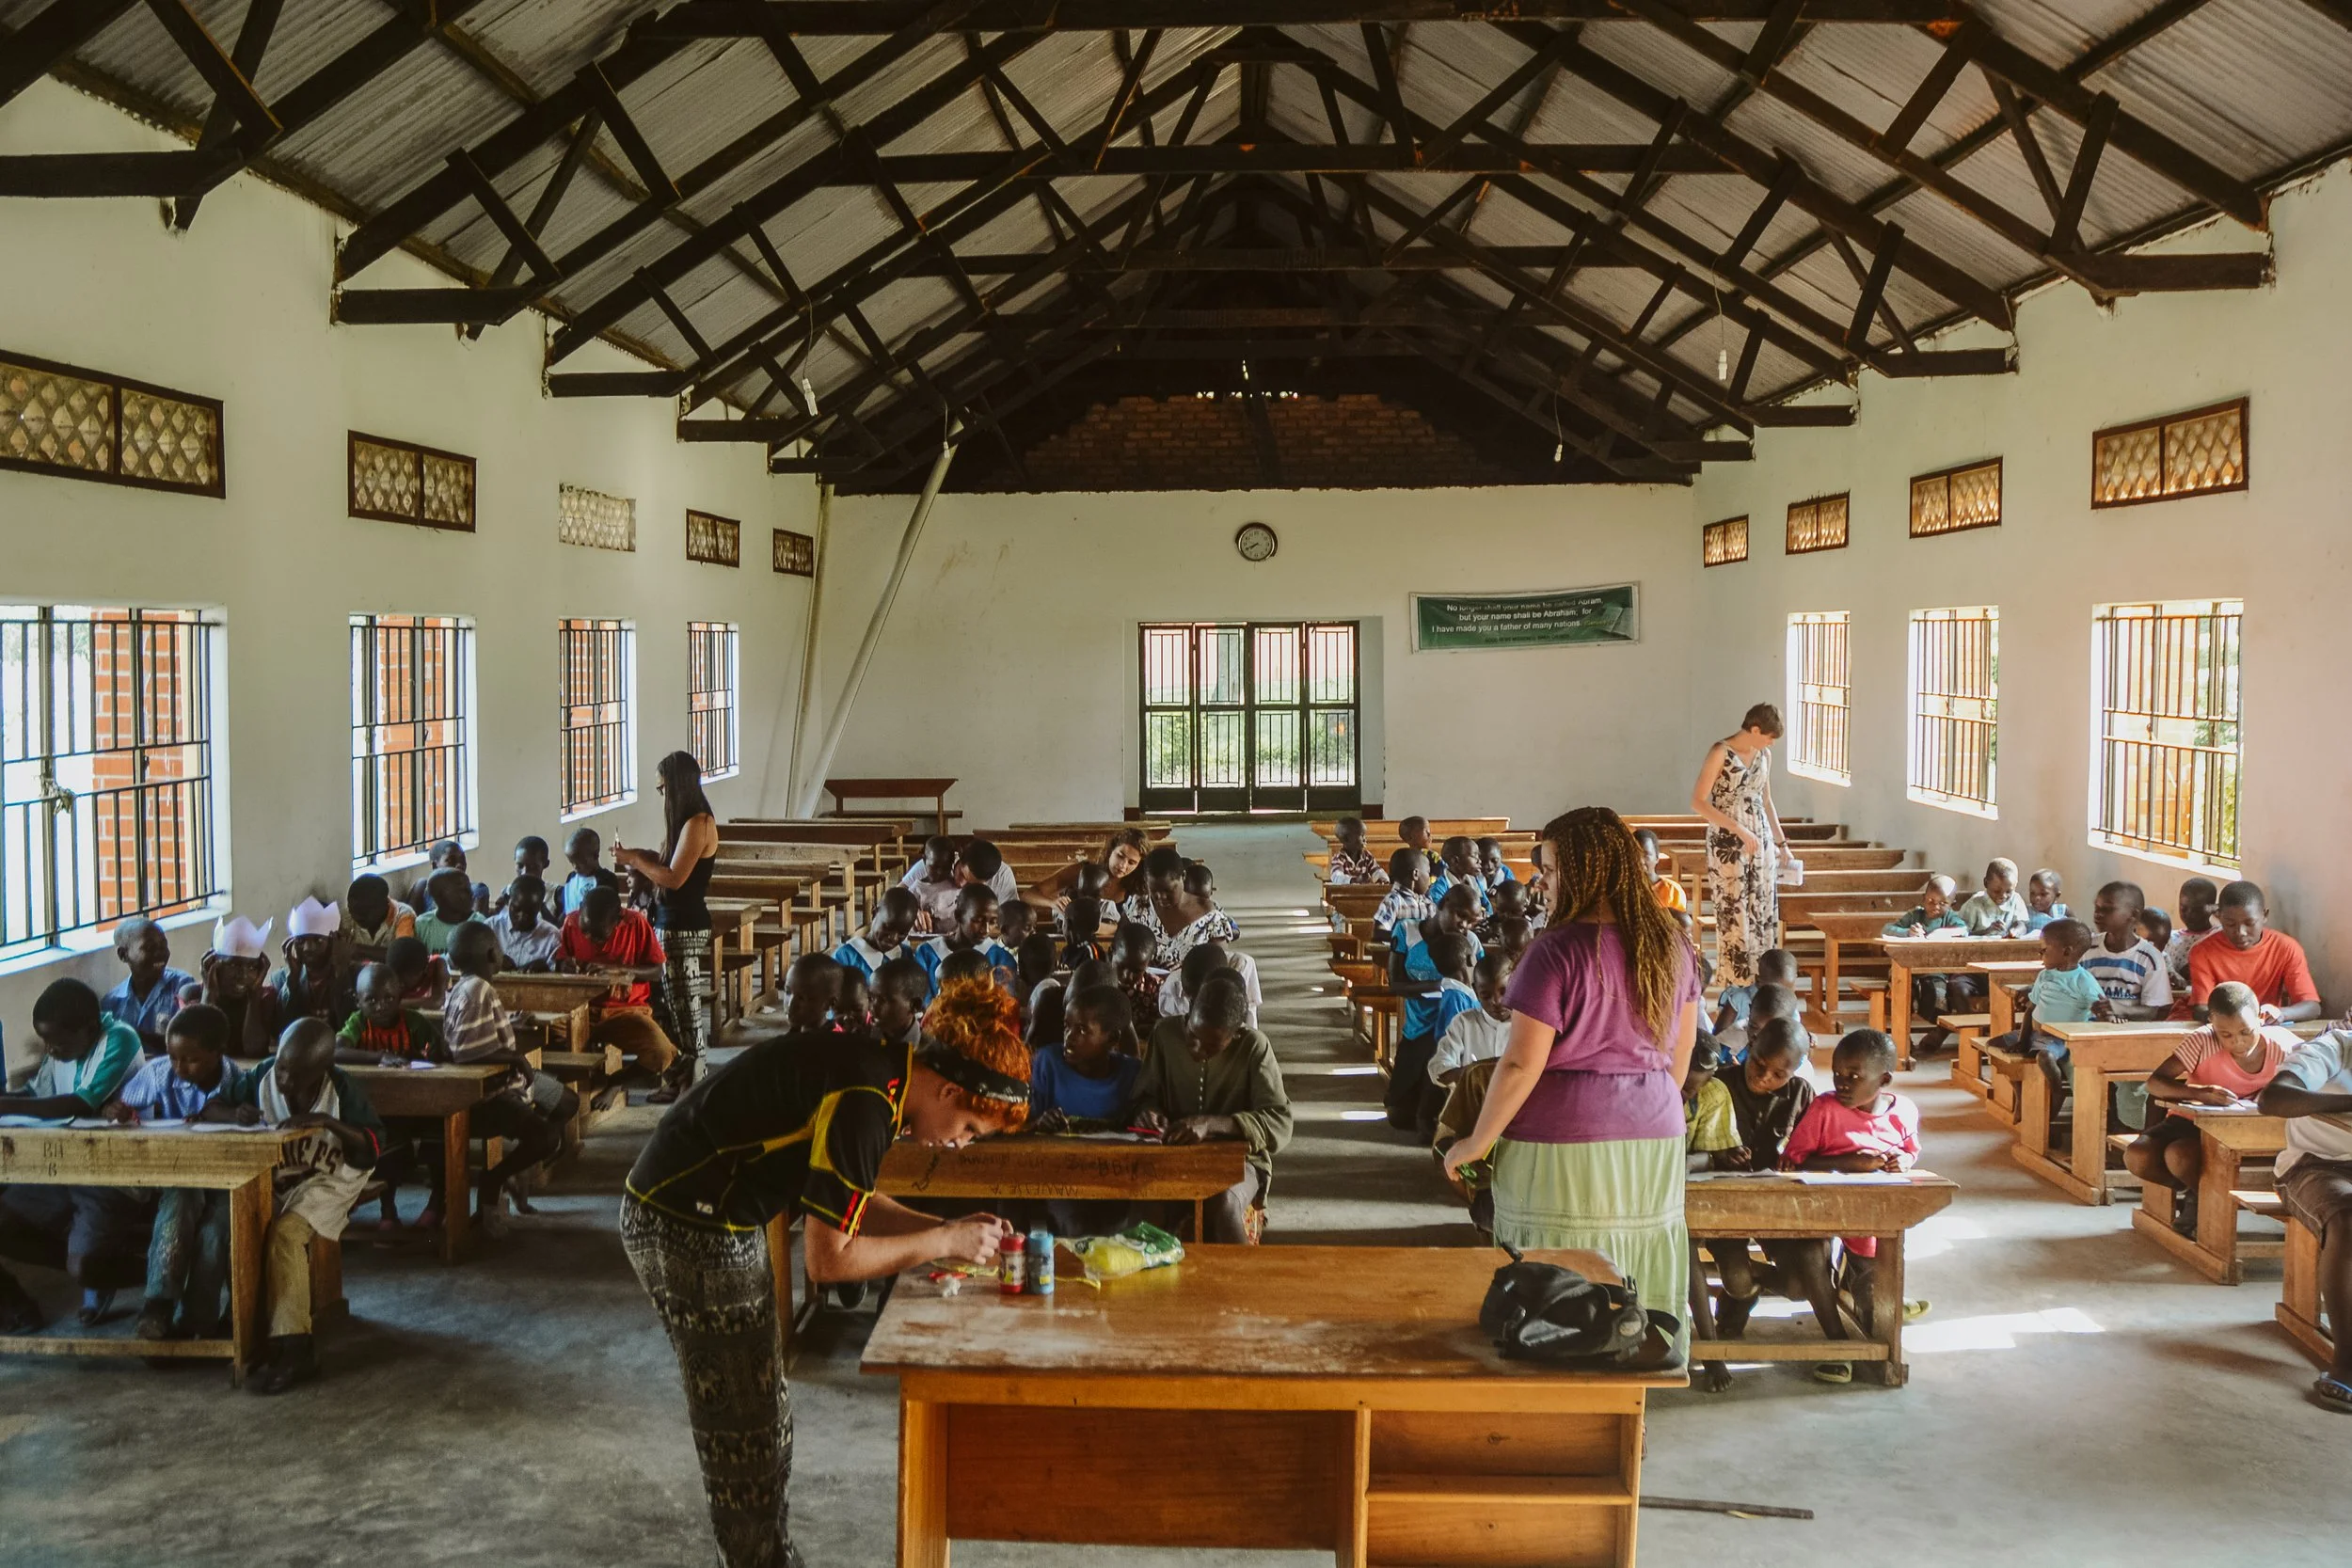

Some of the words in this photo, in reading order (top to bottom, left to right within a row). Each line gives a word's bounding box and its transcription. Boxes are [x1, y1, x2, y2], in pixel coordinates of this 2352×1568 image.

[1459, 604, 1482, 612] longer
[1478, 625, 1492, 634] you
[1500, 623, 1522, 631] father
[1523, 622, 1532, 630] of
[1533, 622, 1553, 630] many
